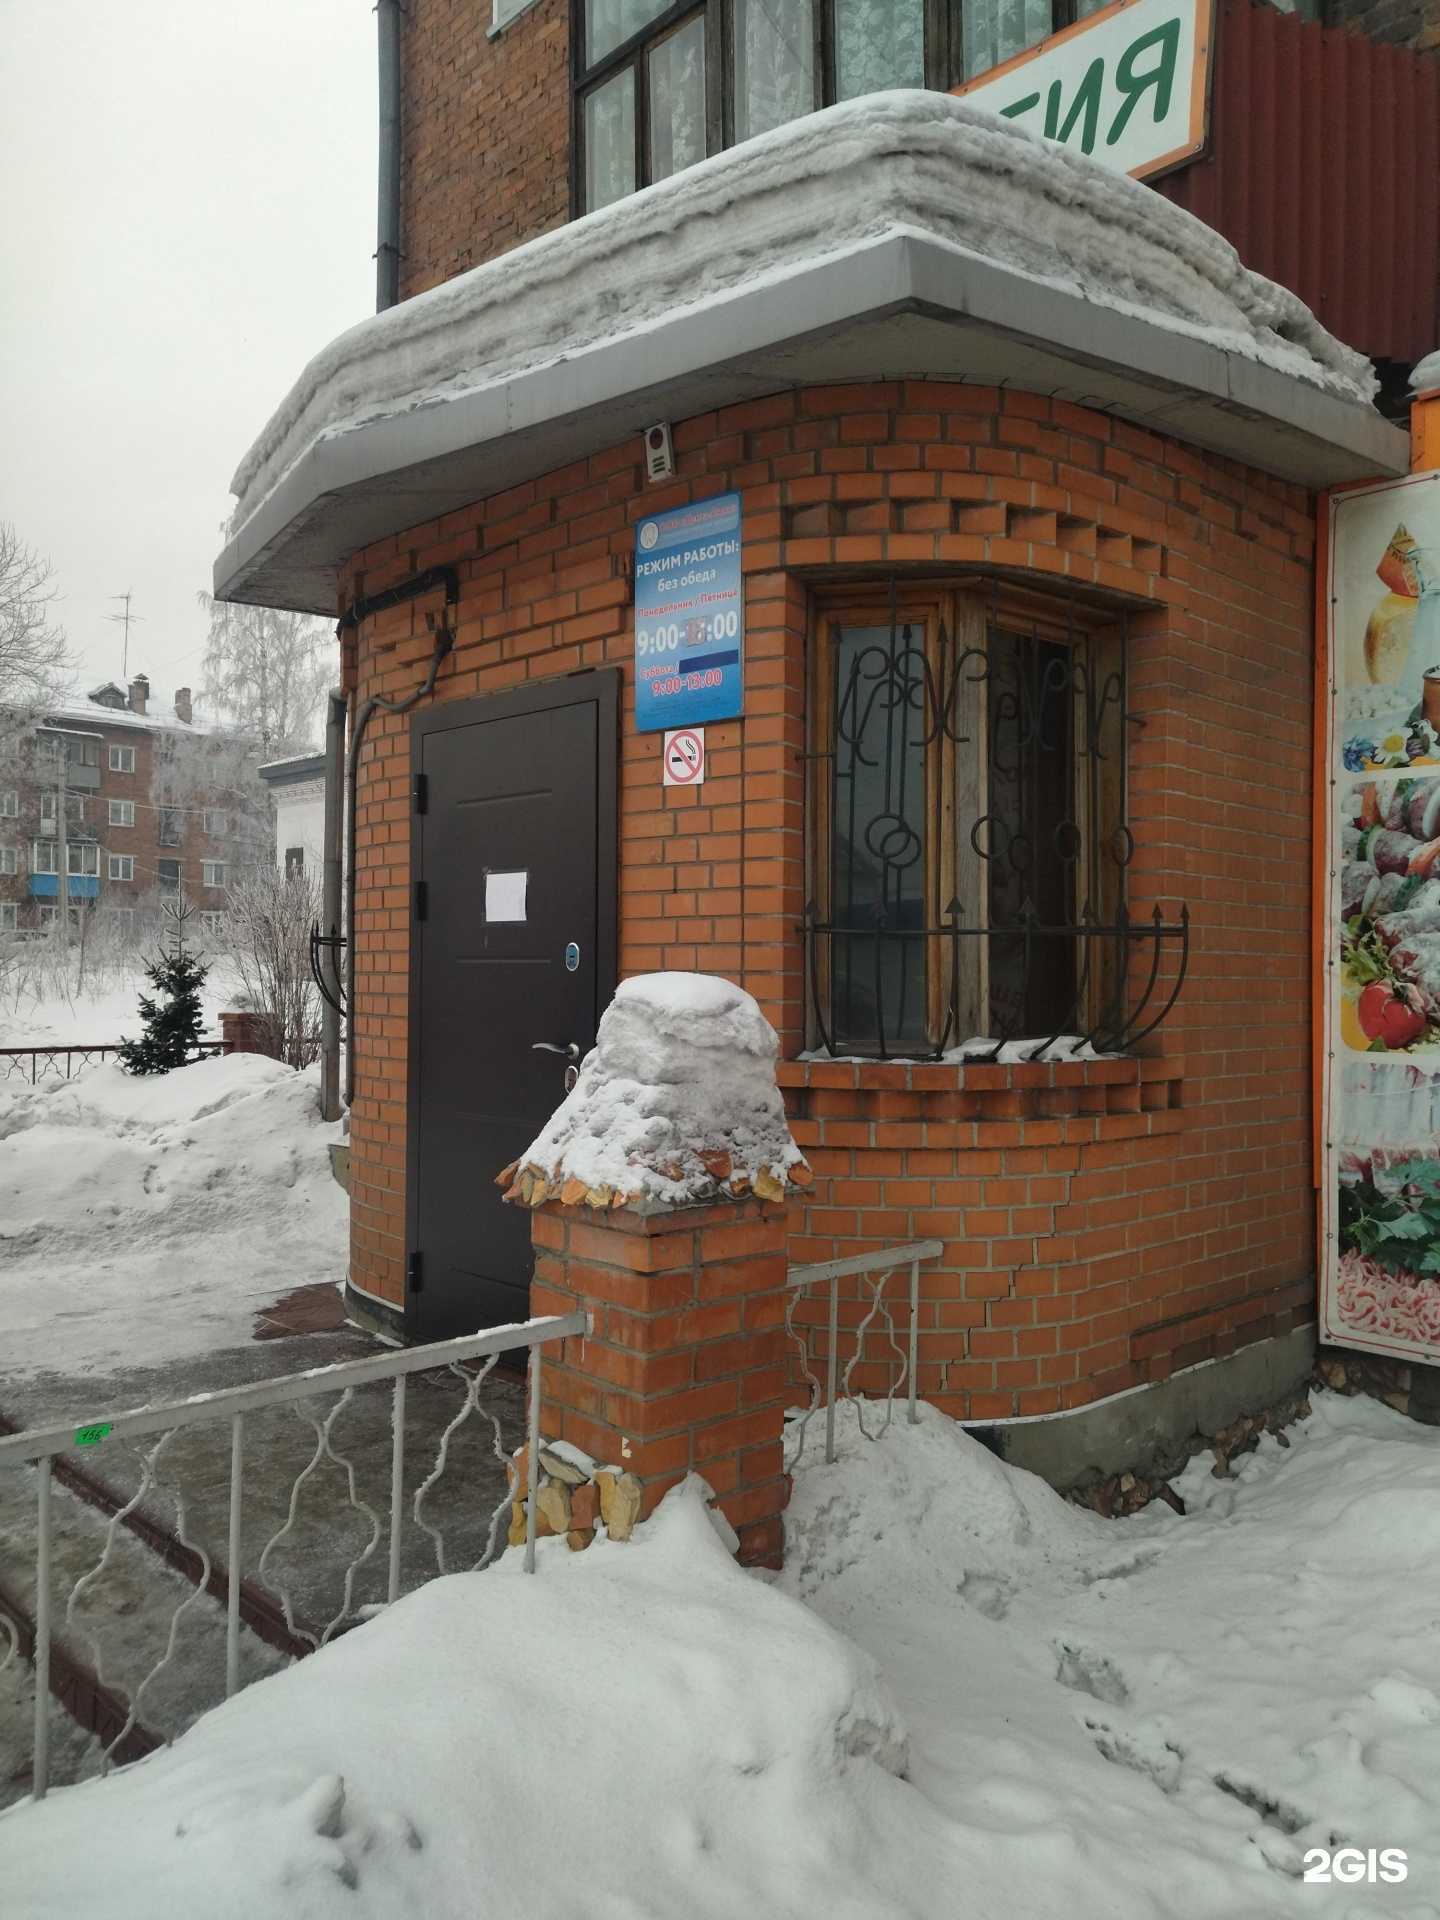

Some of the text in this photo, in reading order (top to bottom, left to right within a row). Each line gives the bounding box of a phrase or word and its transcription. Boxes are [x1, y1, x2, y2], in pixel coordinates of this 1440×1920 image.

[999, 17, 1181, 156] ИЯ
[636, 540, 739, 578] РЕЖИМ РАБОТЫ:
[658, 569, 716, 592] без обеда
